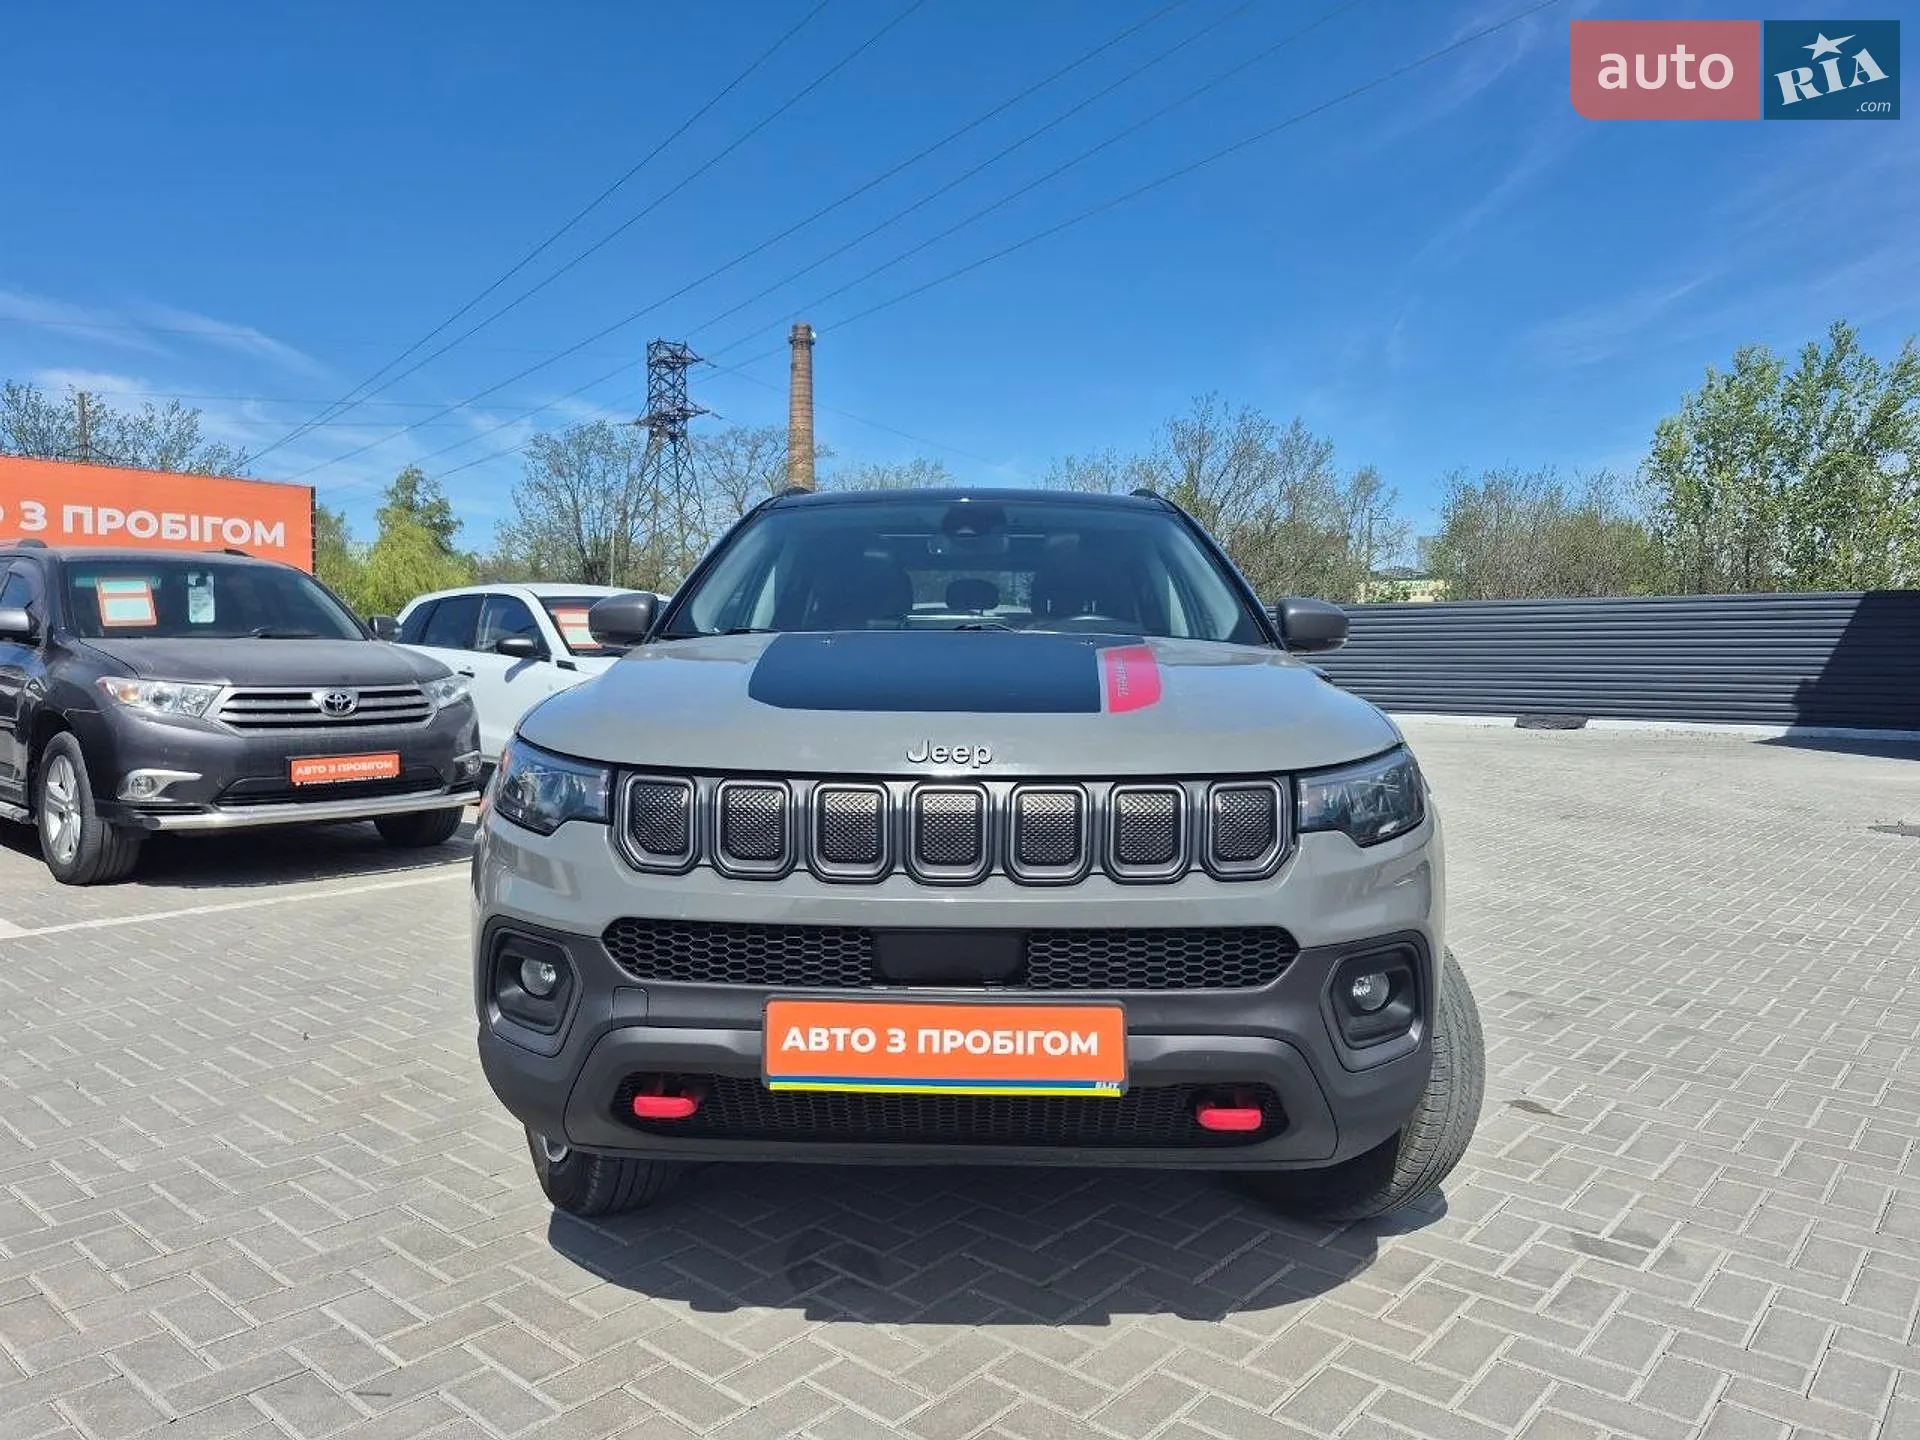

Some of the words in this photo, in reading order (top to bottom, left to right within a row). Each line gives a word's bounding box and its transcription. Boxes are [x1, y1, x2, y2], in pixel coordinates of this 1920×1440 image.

[19, 500, 48, 532] З
[63, 503, 286, 548] ПРОБІГОМ
[296, 764, 327, 776] АВТО
[338, 760, 393, 774] ПРОБІГОМ
[906, 739, 993, 768] Jeep
[781, 1026, 878, 1053] АВТО
[886, 1028, 907, 1055] З
[917, 1028, 1099, 1057] ПРОБІГОМ
